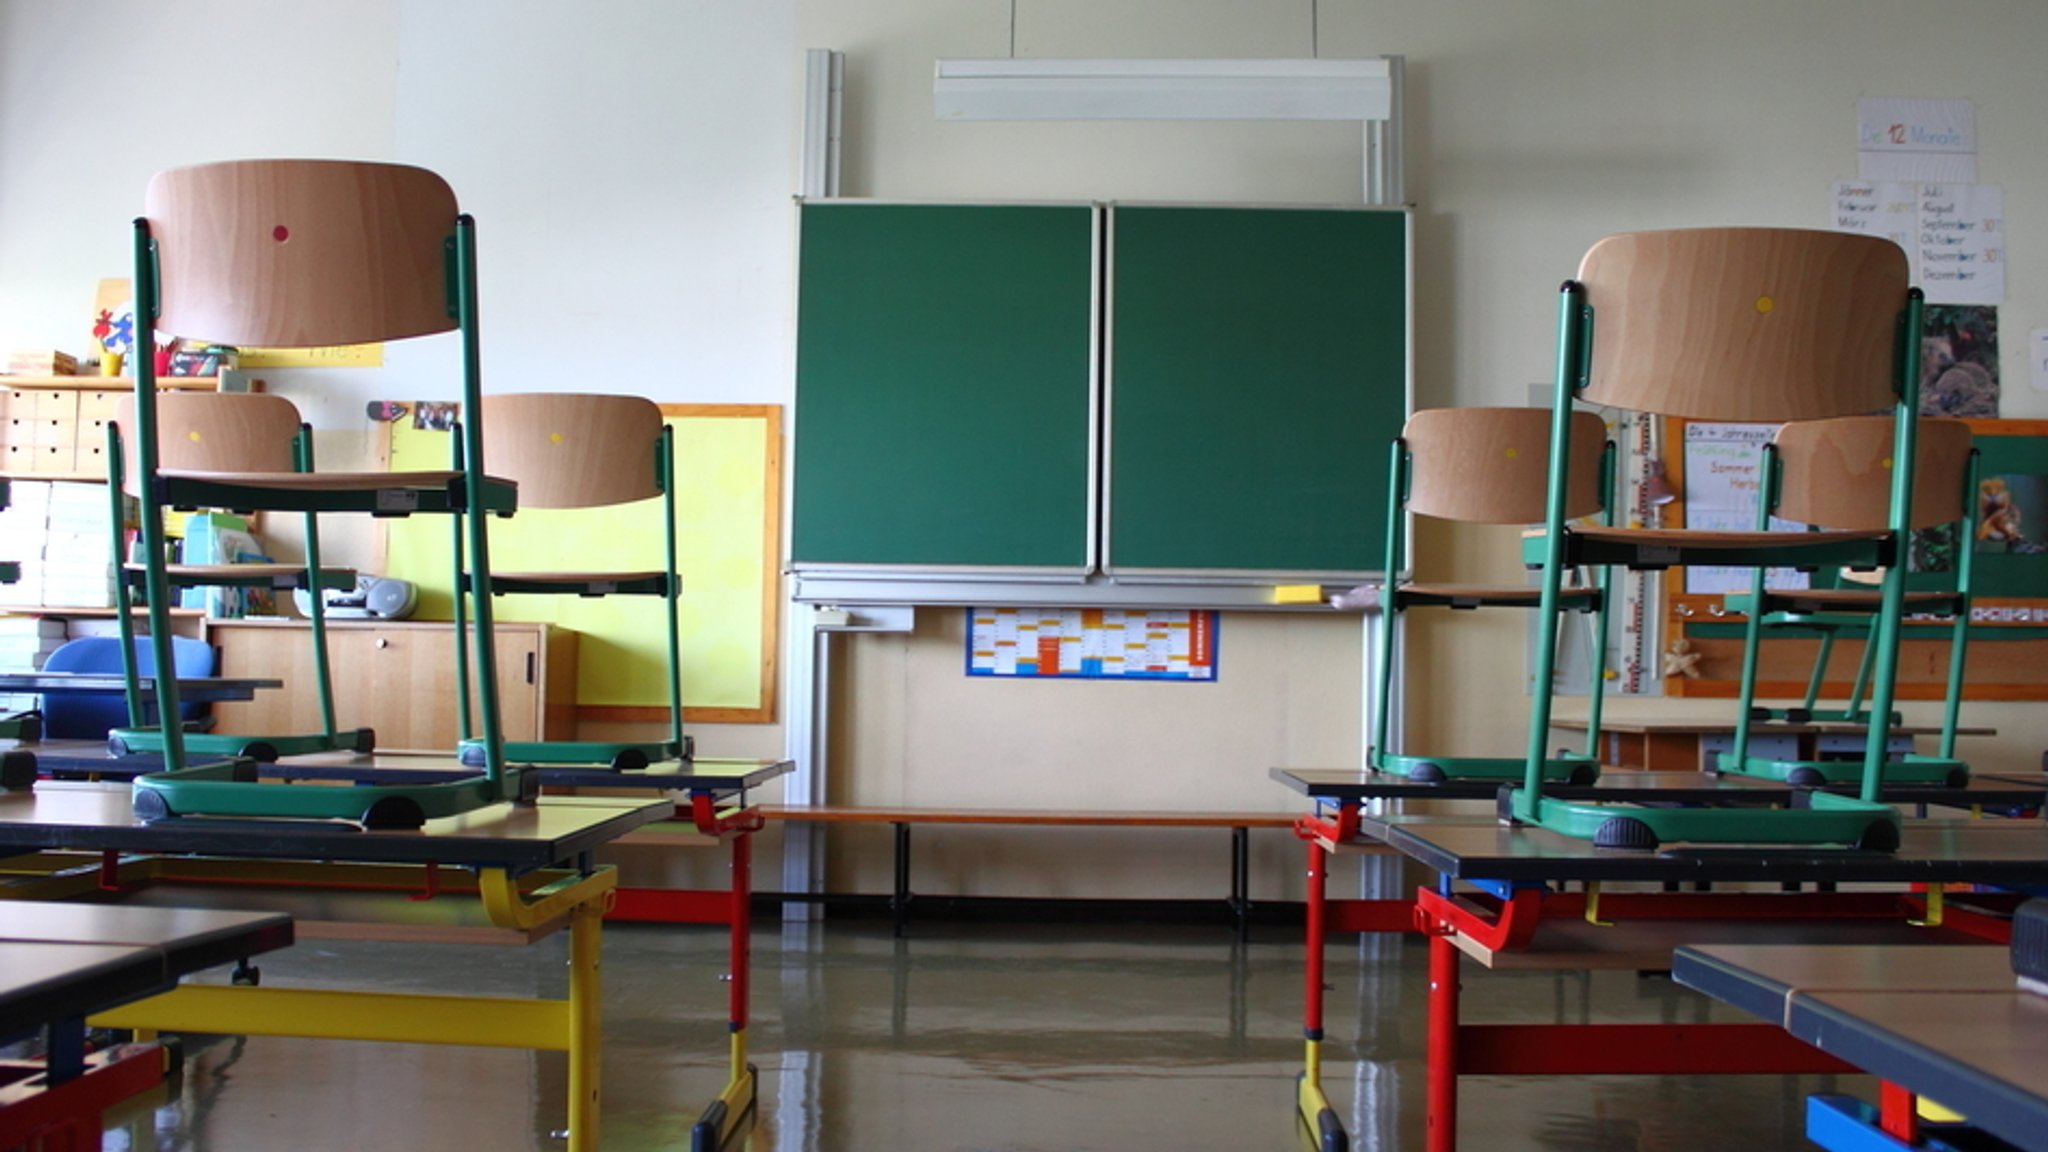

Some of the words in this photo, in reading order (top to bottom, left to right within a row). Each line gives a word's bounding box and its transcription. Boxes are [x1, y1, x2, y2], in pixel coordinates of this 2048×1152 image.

[1888, 123, 1906, 144] 12
[1911, 126, 1961, 144] Monate
[1922, 201, 1954, 217] August
[1922, 218, 1976, 232] September
[1920, 232, 1965, 245] Oktober
[1922, 248, 1977, 262] November
[1922, 266, 1977, 280] Dezember
[1710, 461, 1754, 473] Sommer
